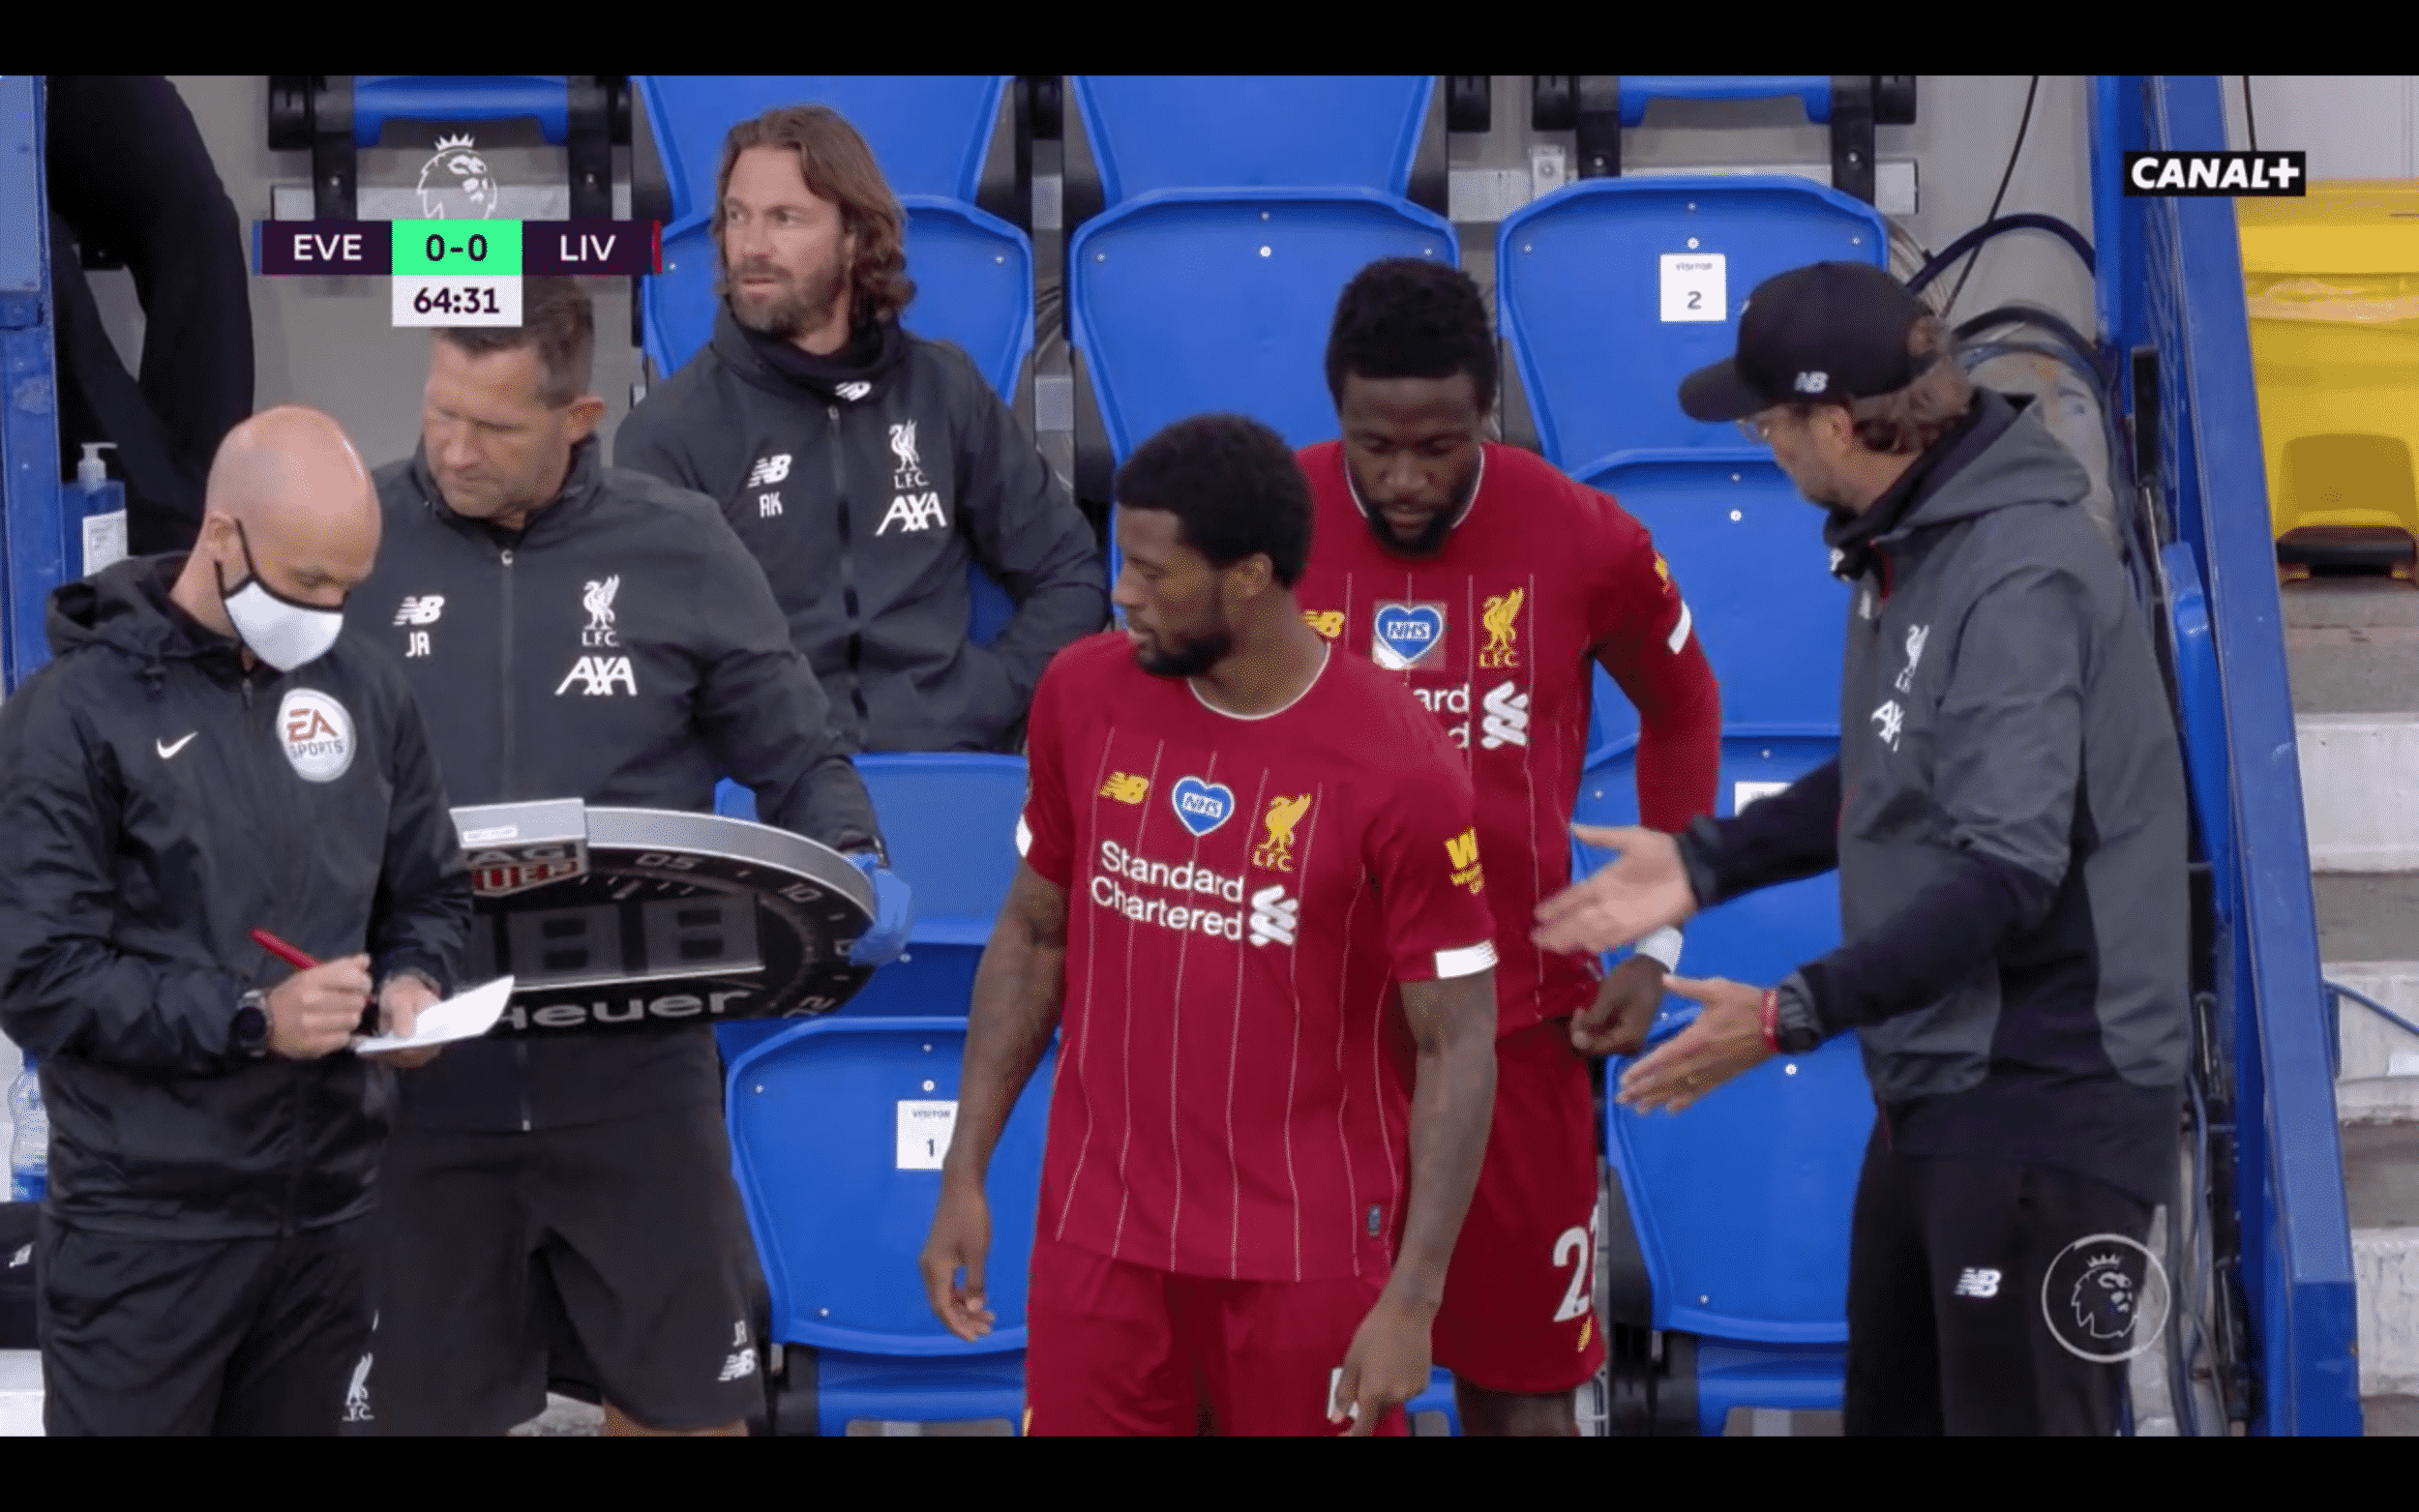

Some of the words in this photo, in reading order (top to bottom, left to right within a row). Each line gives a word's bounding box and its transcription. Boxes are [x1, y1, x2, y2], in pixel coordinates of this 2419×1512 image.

[1687, 290, 1702, 310] 2
[875, 491, 947, 537] AXA
[1388, 621, 1431, 639] NHS
[554, 655, 638, 697] AXA
[286, 708, 340, 743] EA
[289, 739, 345, 759] SPORTS
[468, 844, 566, 866] AG
[1101, 840, 1244, 903] Standard
[1090, 876, 1243, 941] Chartered
[926, 1139, 935, 1158] 1
[1553, 1202, 1598, 1322] 2
